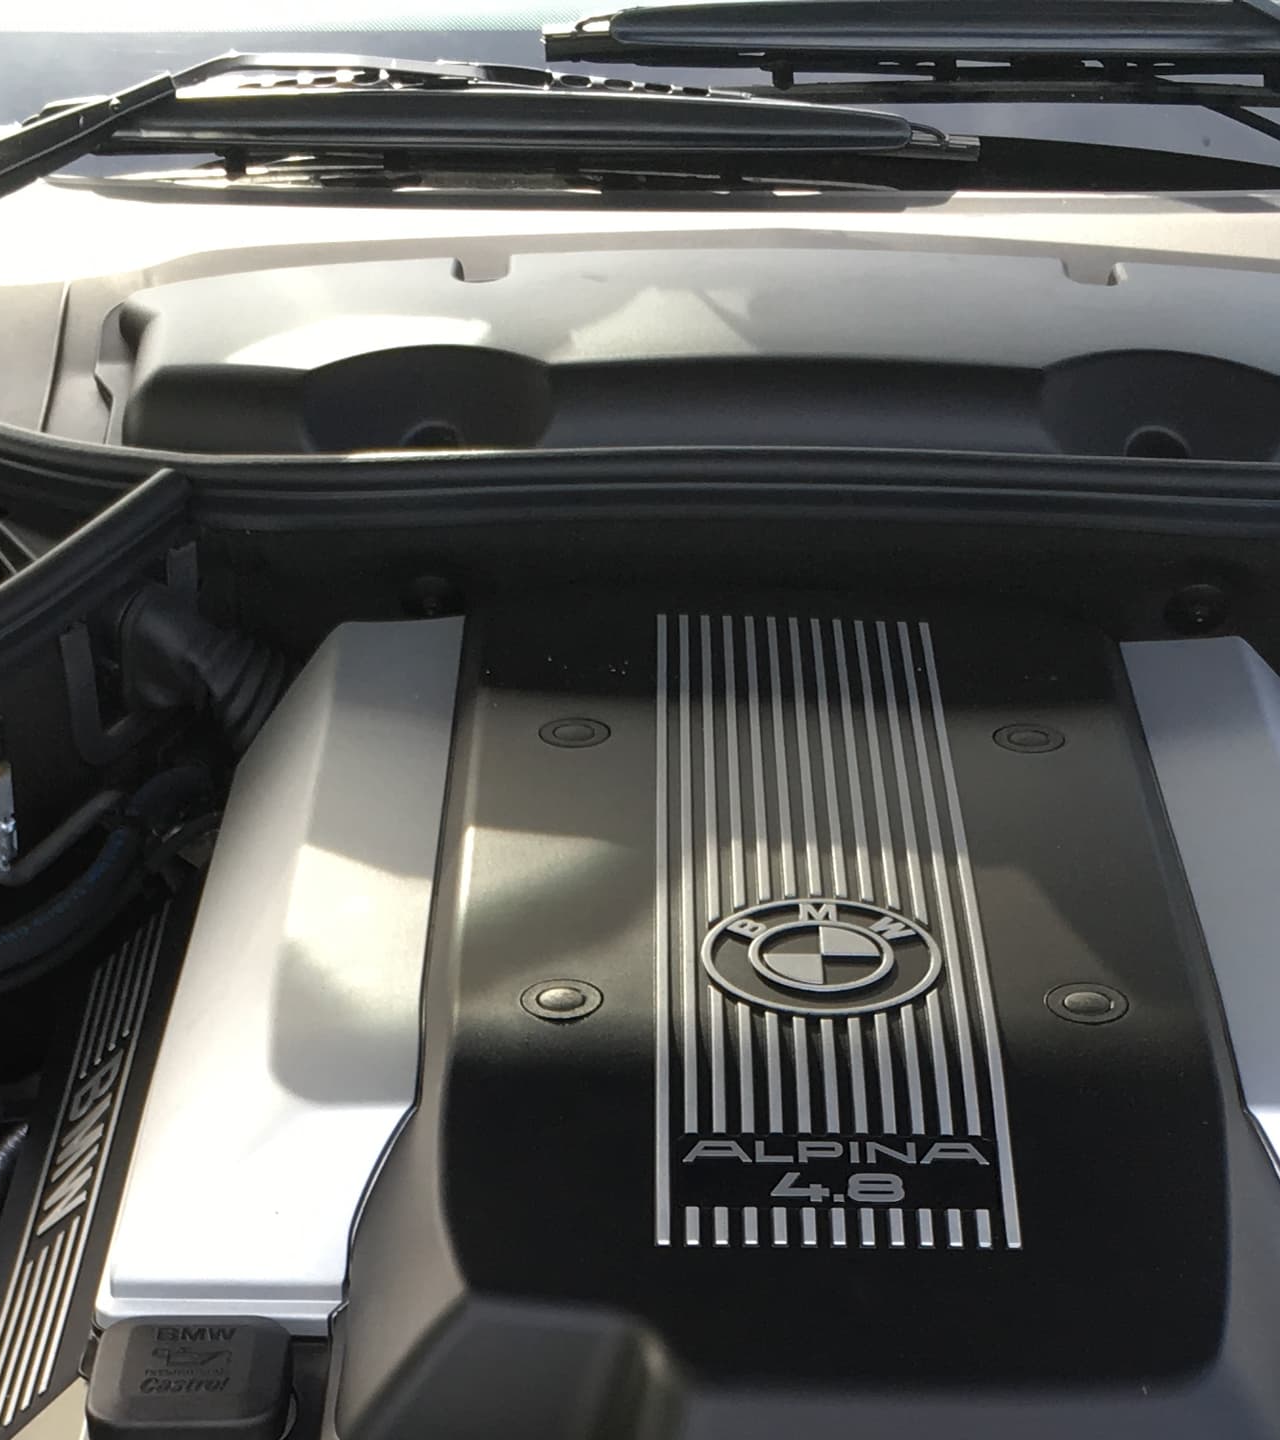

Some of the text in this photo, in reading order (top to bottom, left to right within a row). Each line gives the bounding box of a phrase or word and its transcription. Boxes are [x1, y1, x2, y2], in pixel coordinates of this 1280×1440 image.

[725, 902, 917, 941] BMW
[36, 1046, 124, 1238] BMW
[682, 1140, 991, 1166] ALPINA
[769, 1172, 906, 1203] 4.8
[156, 1327, 237, 1341] BMW
[140, 1376, 230, 1393] Castrol
